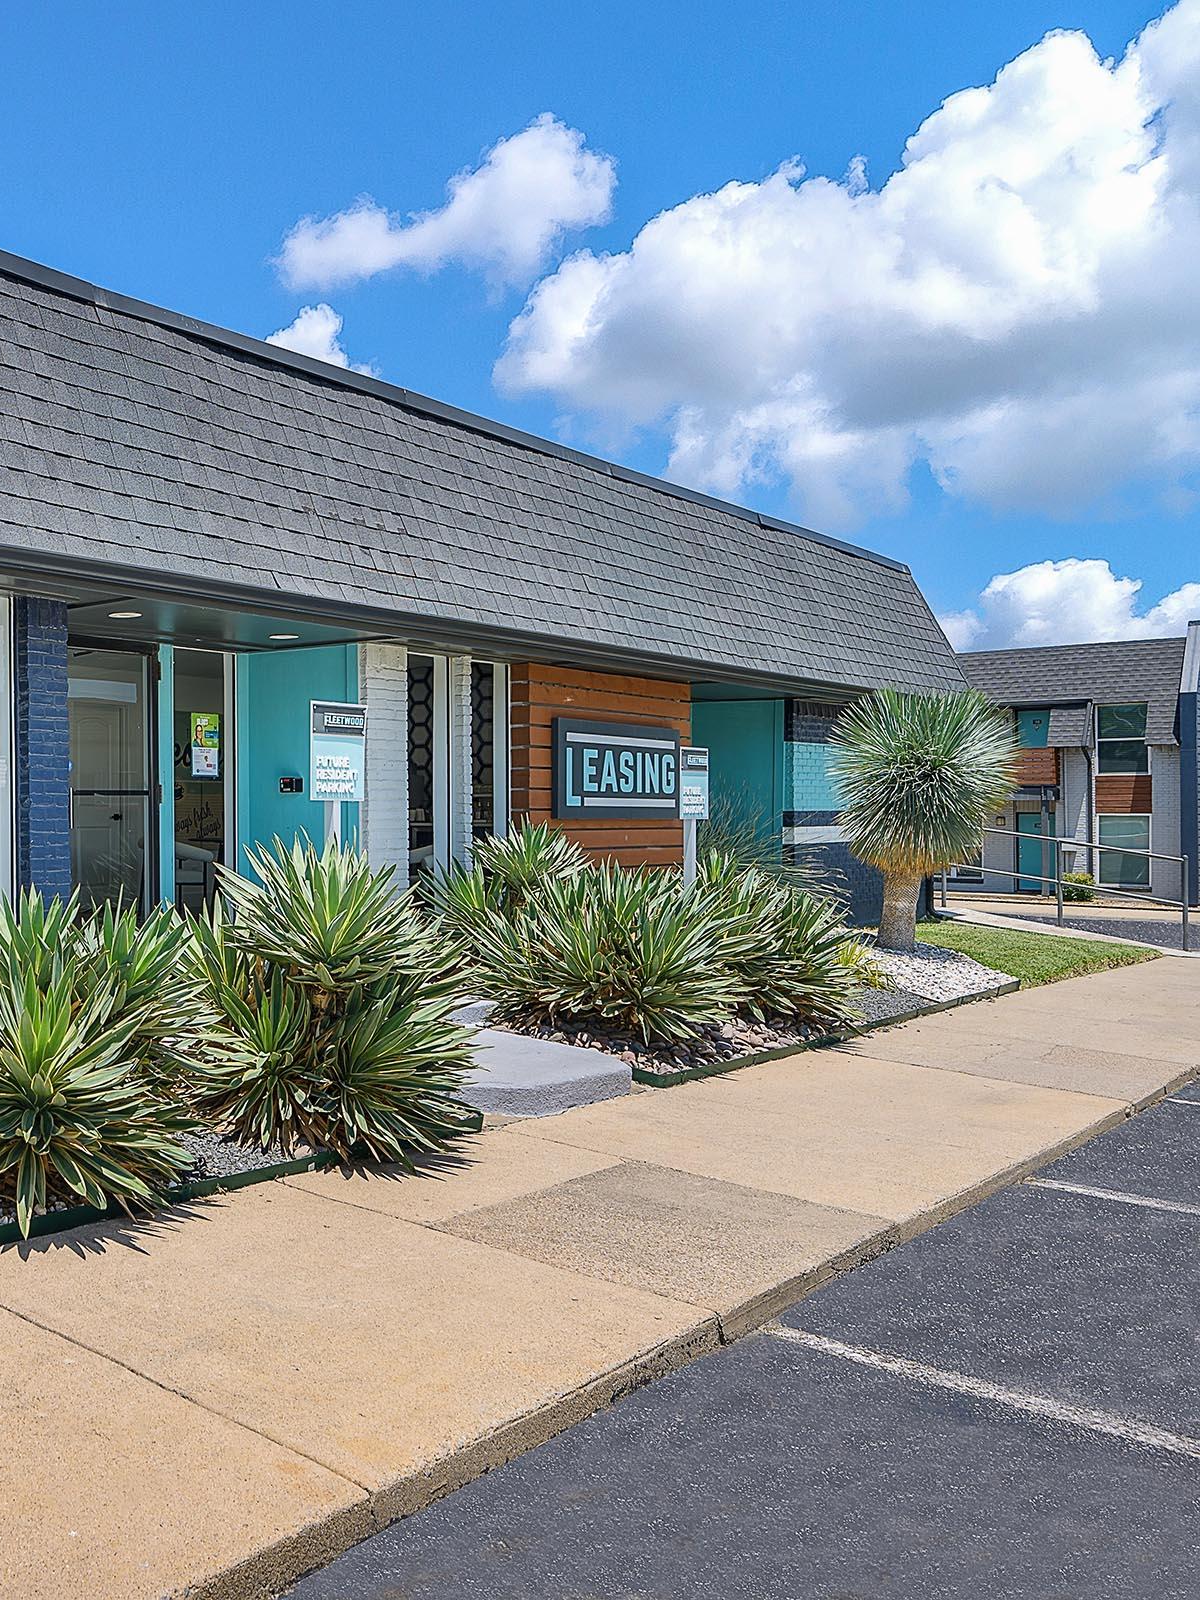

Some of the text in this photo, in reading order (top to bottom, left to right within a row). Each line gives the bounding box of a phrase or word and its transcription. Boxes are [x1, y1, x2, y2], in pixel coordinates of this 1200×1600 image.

[324, 715, 363, 726] FLEETWOOD
[316, 755, 349, 768] FUTURE
[566, 747, 675, 806] LEASING
